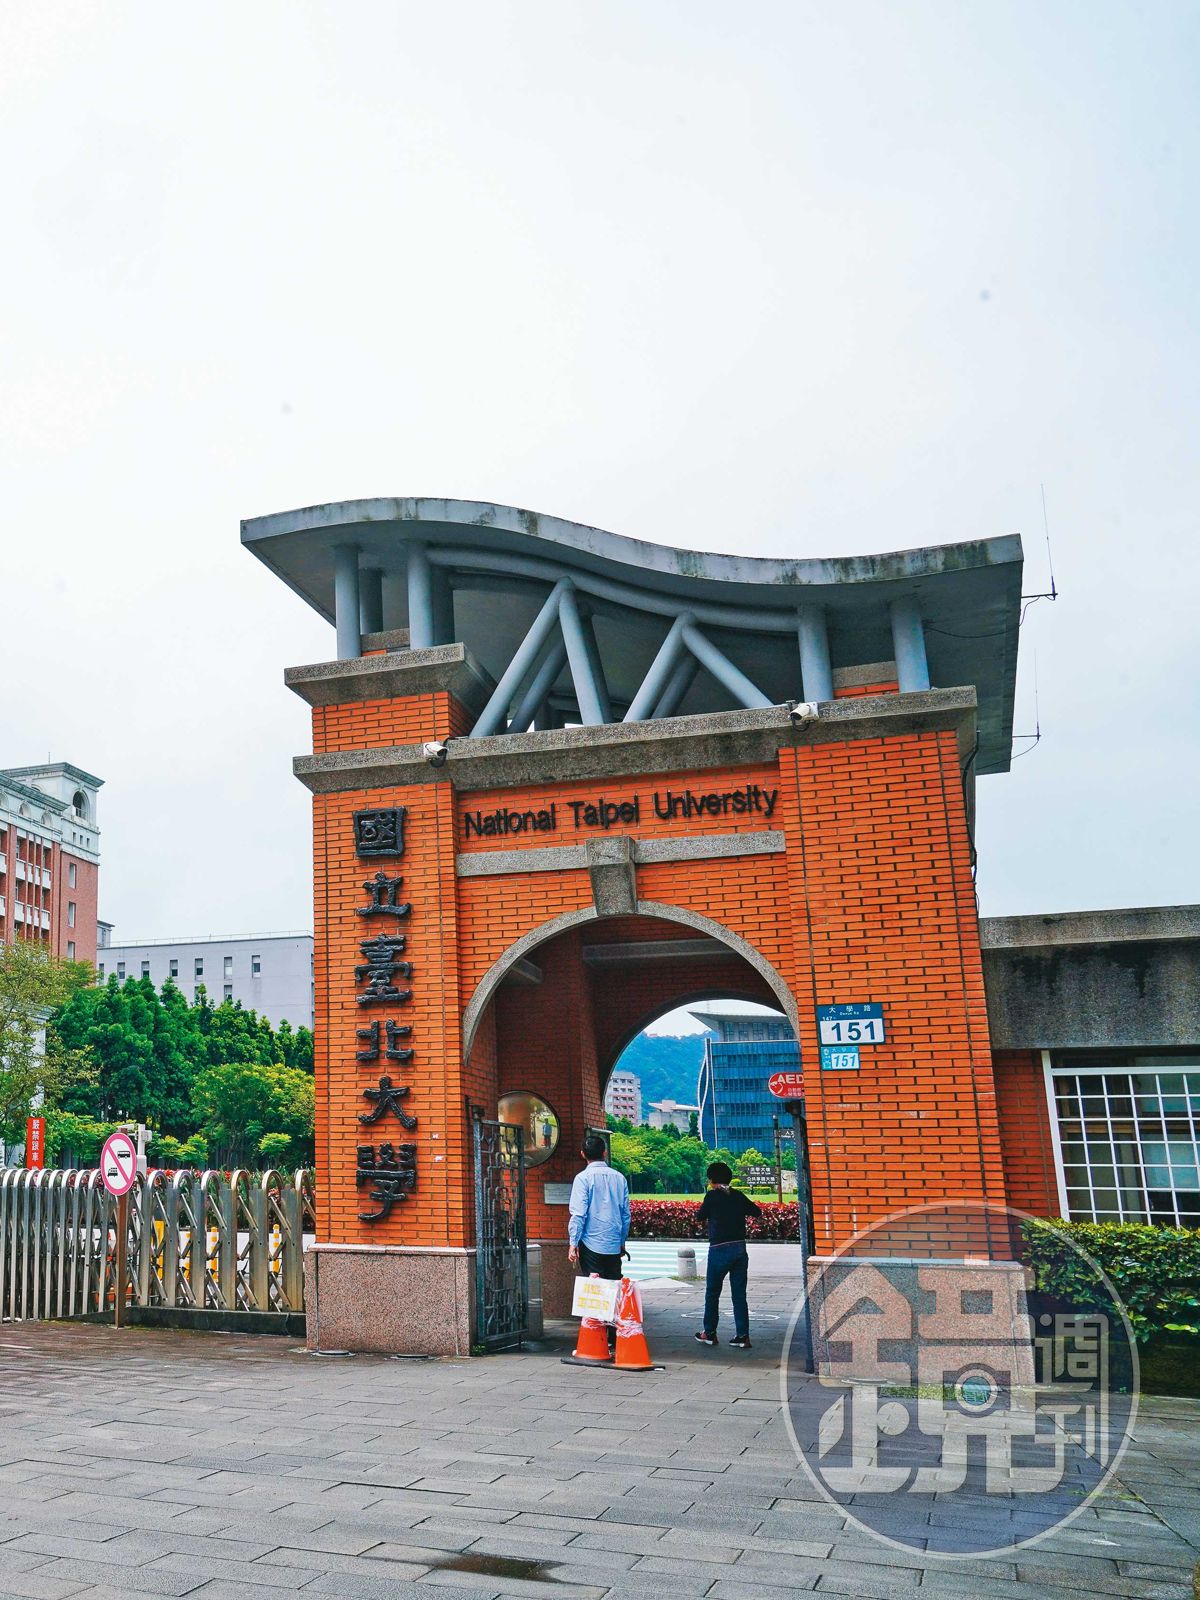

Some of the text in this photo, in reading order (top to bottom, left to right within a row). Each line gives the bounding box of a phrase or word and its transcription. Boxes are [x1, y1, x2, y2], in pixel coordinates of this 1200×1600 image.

[464, 783, 779, 838] National Taipei University
[352, 805, 418, 1223] 國立臺北大學
[829, 1005, 871, 1013] 大學路
[831, 1021, 875, 1041] 151
[834, 1055, 855, 1067] 151
[777, 1074, 804, 1084] AED
